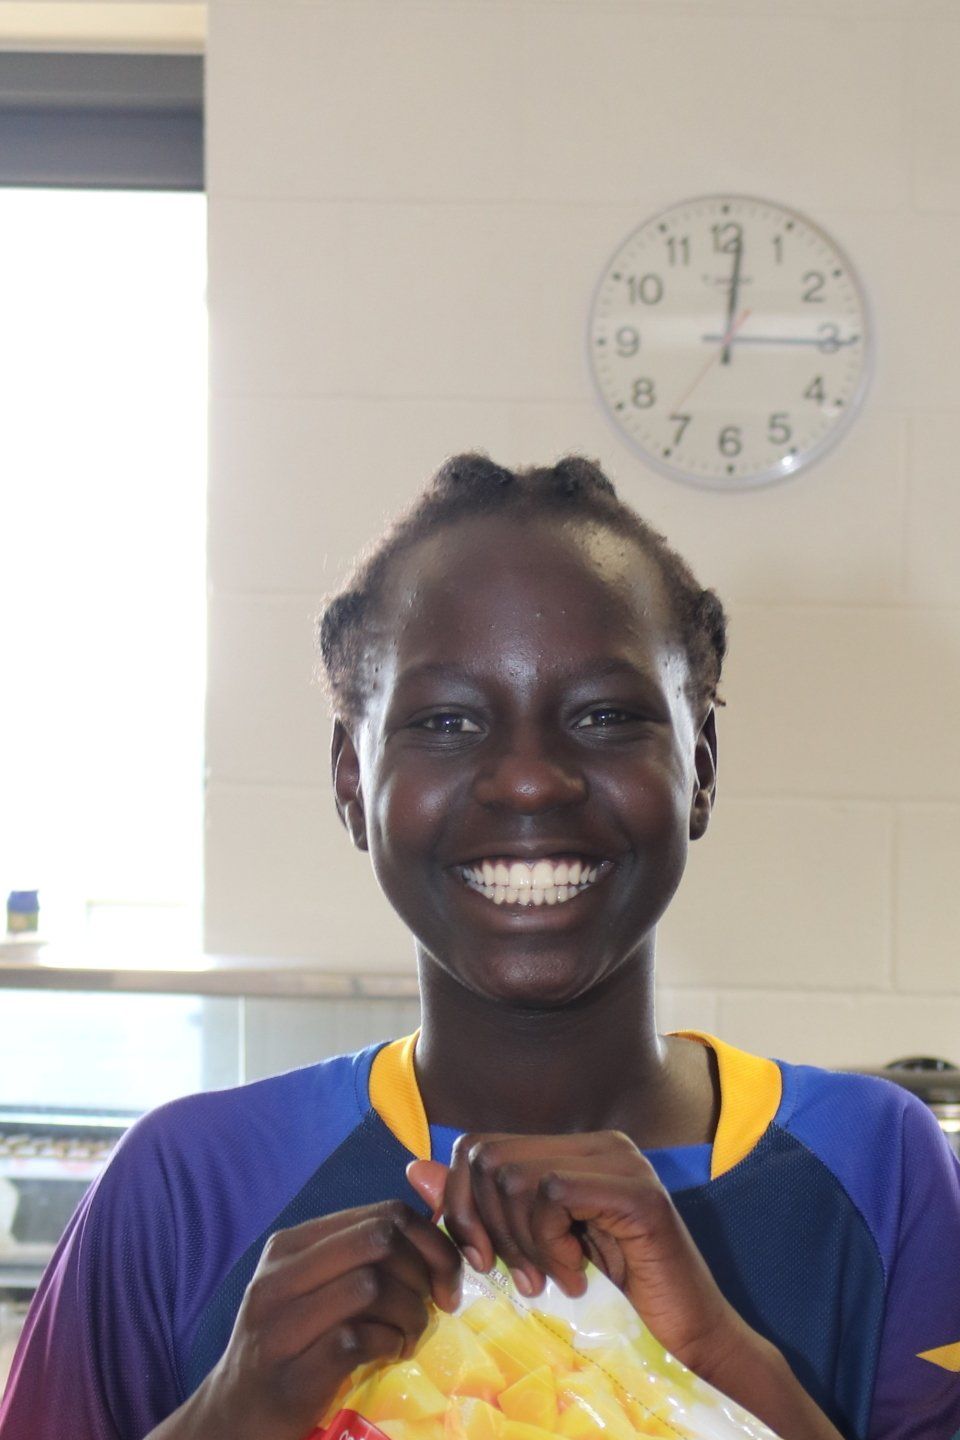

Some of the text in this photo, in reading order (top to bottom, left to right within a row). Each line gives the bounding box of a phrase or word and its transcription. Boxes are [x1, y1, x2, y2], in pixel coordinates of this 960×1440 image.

[667, 236, 691, 266] 11
[711, 222, 744, 254] 12
[771, 235, 783, 265] 1
[627, 273, 664, 305] 10
[801, 271, 826, 303] 2
[615, 326, 640, 358] 9
[817, 323, 841, 355] 3
[631, 377, 656, 409] 8
[803, 375, 827, 404] 4
[669, 413, 692, 446] 7
[718, 426, 743, 457] 6
[767, 412, 792, 444] 5
